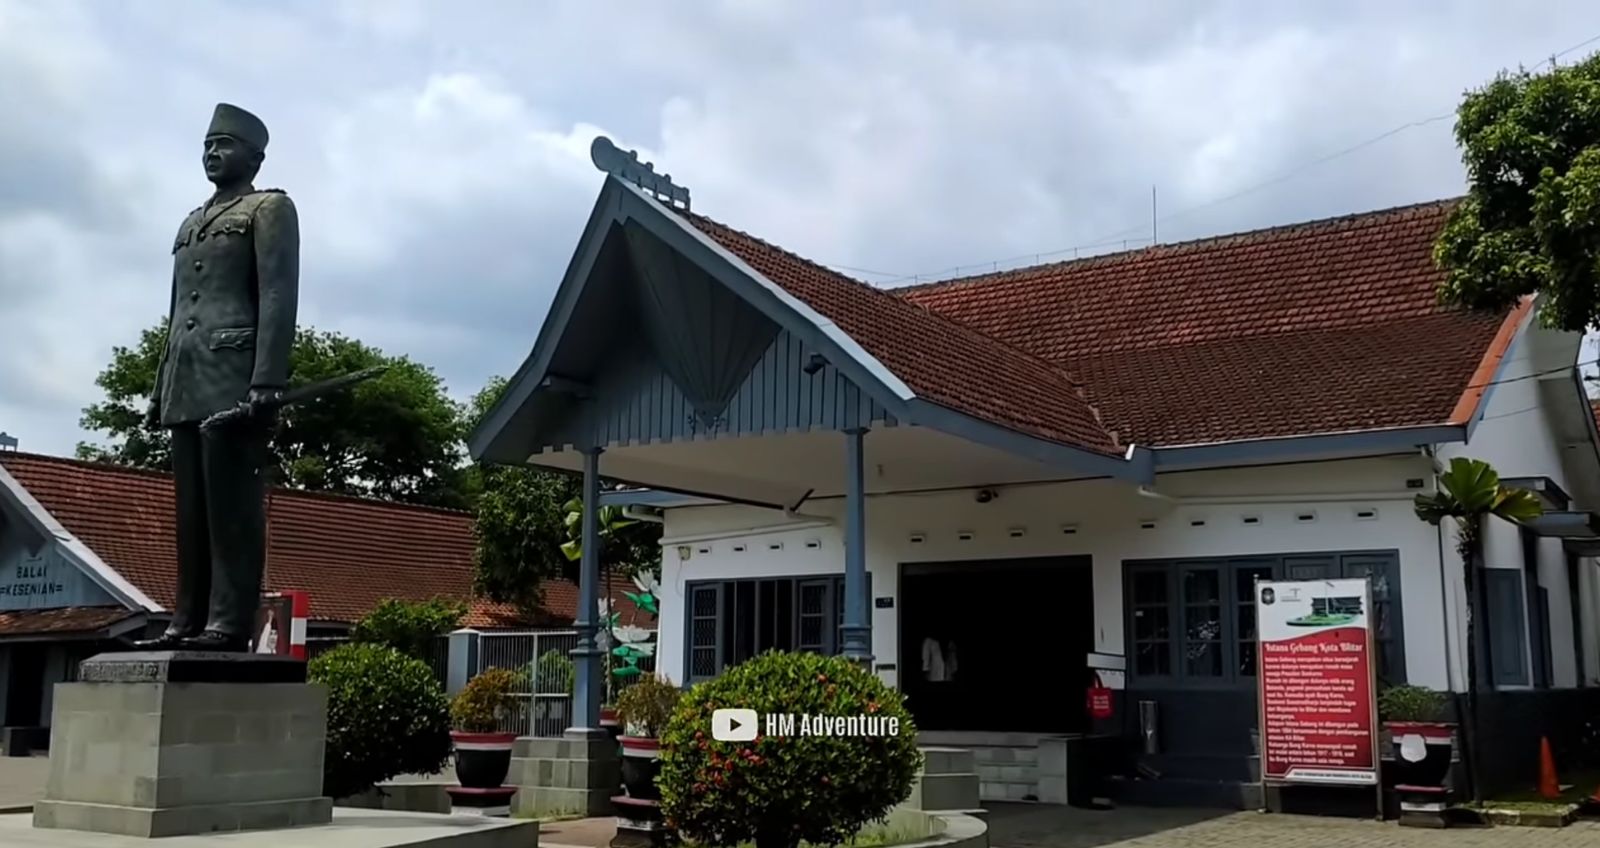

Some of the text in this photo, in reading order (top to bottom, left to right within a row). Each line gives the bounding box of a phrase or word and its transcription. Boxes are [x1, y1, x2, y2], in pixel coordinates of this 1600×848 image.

[16, 566, 47, 578] BALAI
[1290, 642, 1318, 654] Gebang
[1319, 643, 1339, 653] Kota
[1339, 642, 1363, 652] Blitar
